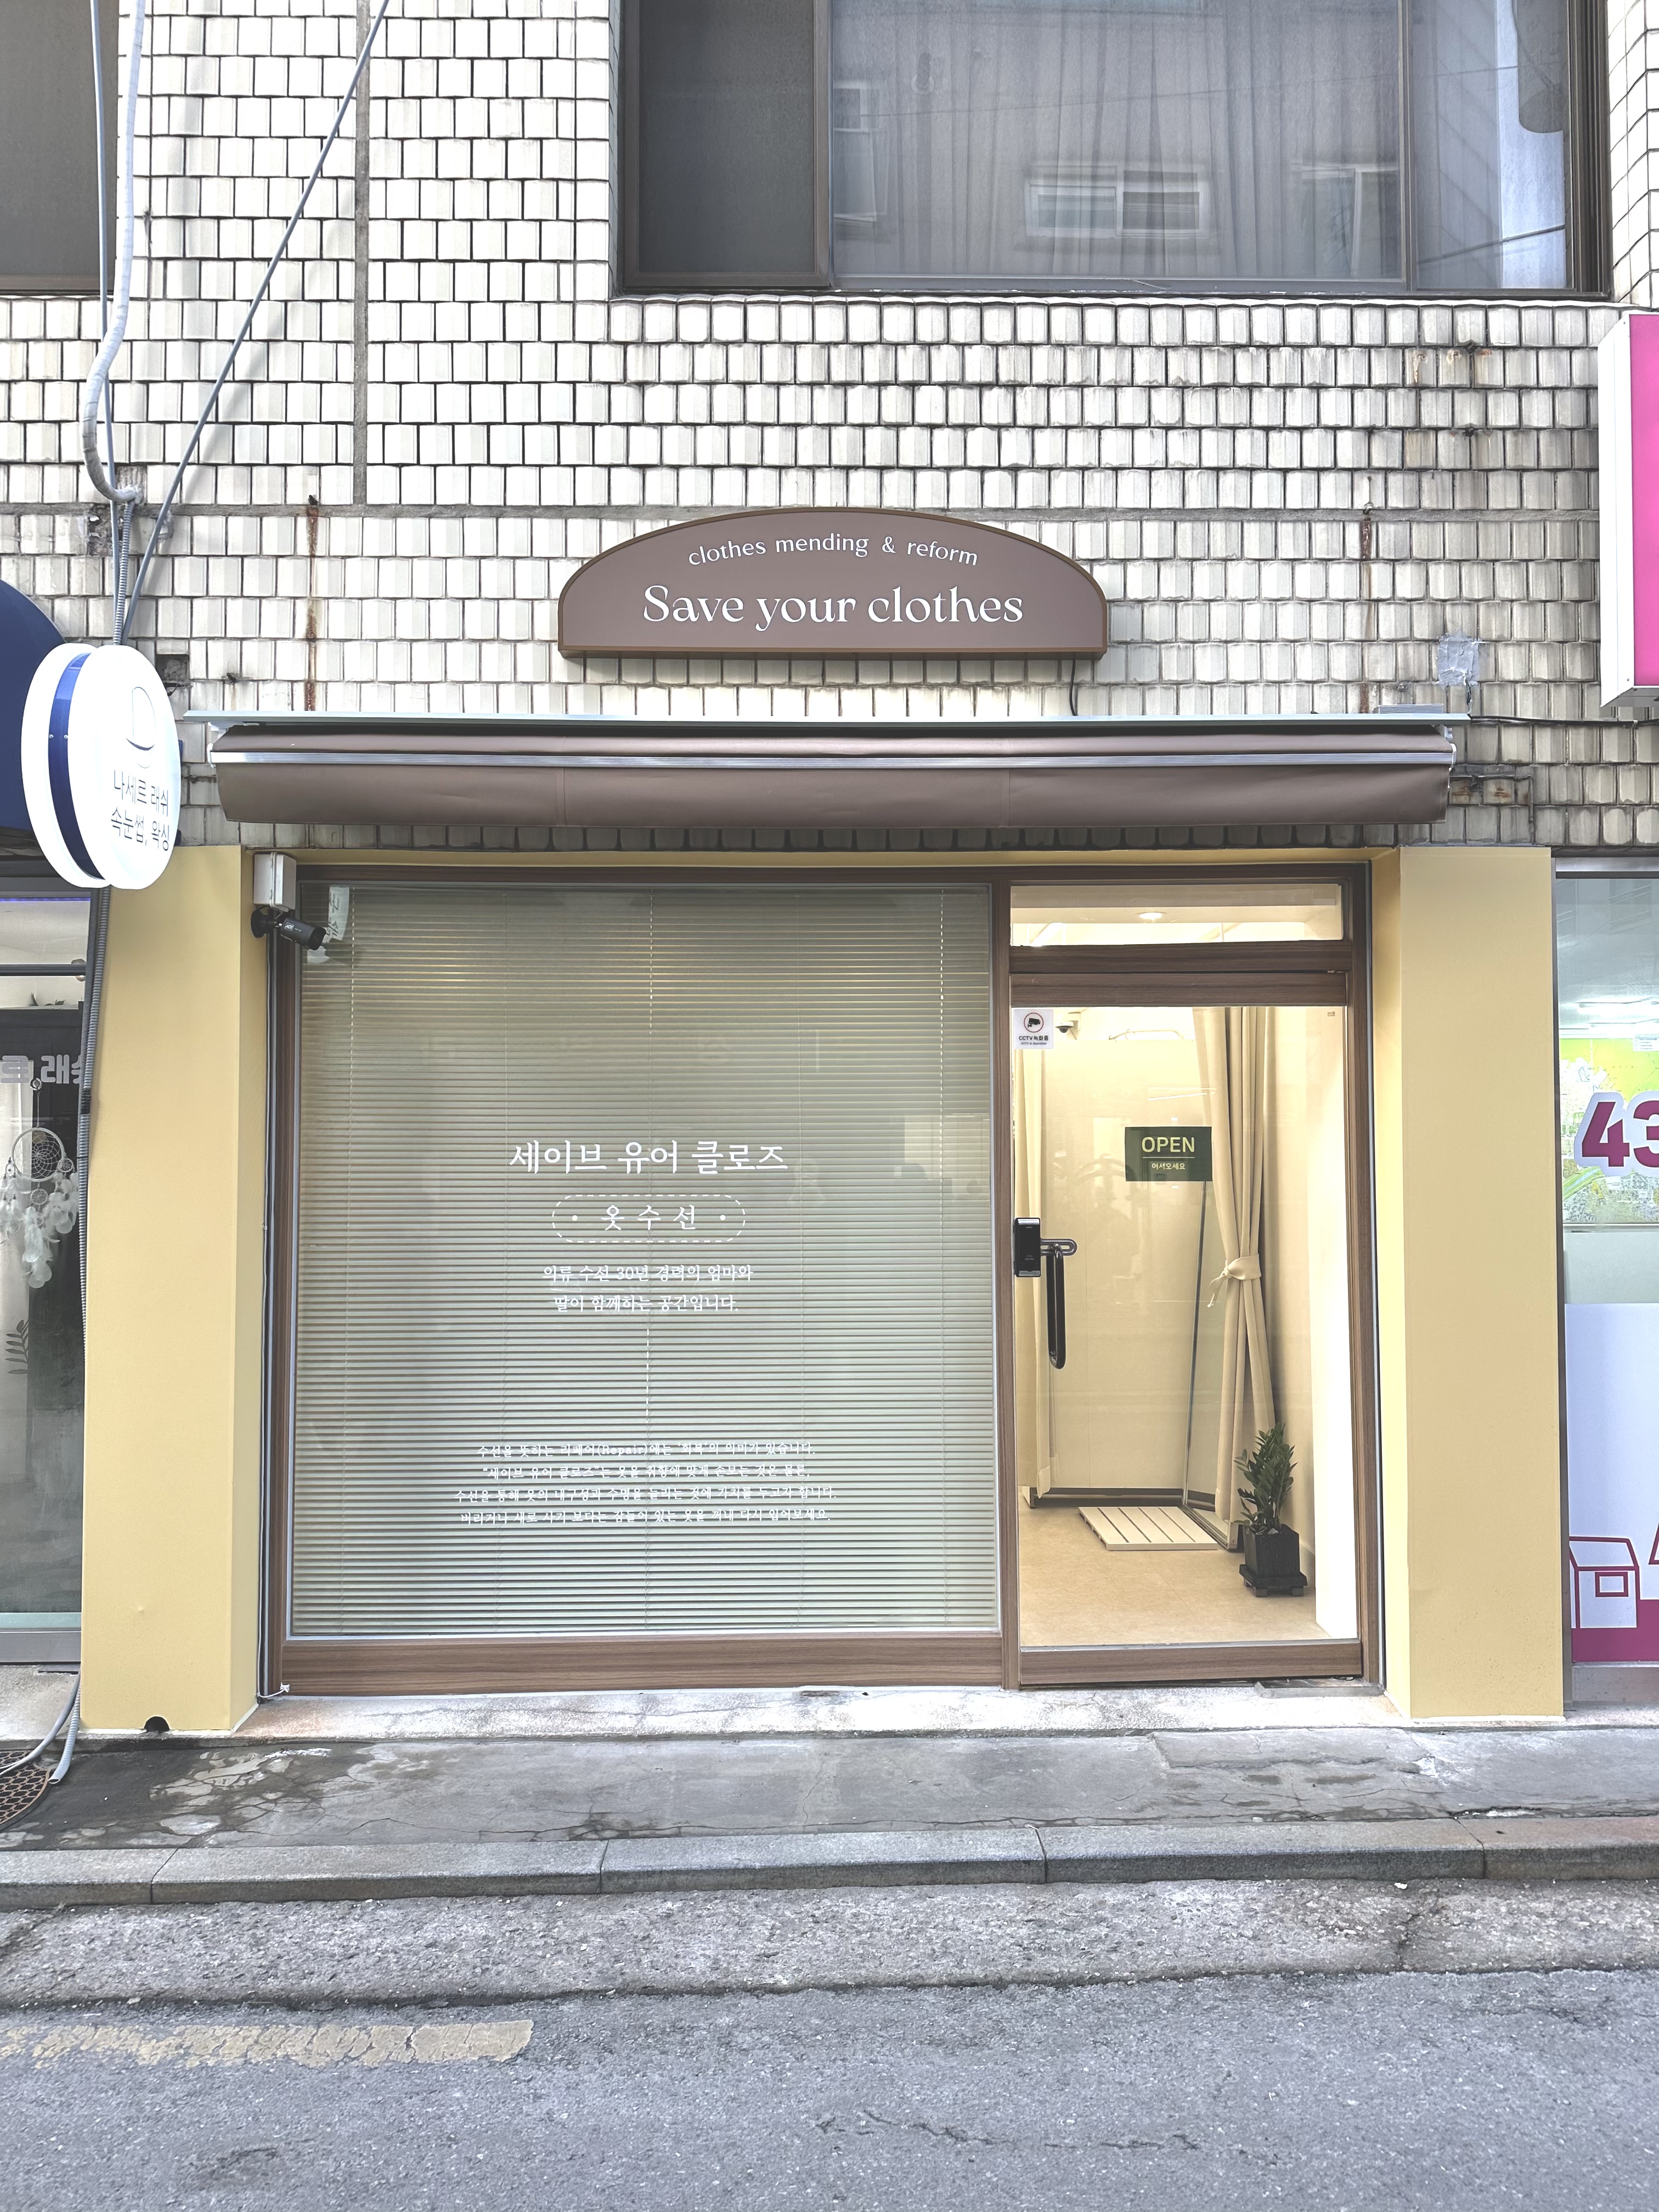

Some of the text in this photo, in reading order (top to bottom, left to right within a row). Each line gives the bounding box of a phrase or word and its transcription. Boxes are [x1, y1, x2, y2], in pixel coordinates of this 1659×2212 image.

[689, 533, 977, 566] clothes mending & reform
[644, 585, 1023, 631] Save your clothes
[114, 769, 168, 817] 나세르 래쉬
[111, 806, 169, 851] 속눈썹, 왁싱
[1142, 1136, 1195, 1153] OPEN
[509, 1140, 788, 1175] 세이브 유어 클로즈
[543, 1264, 754, 1283] 의류 수선 30년 경력의 엄마와
[554, 1294, 738, 1312] 딸이 함께하는 공간입니다.
[477, 1444, 514, 1458] 수선을
[518, 1443, 555, 1458] 뜻하는
[725, 1442, 761, 1455] 의미가
[765, 1441, 816, 1455] 있습니다.
[529, 1466, 552, 1480] 유어
[618, 1465, 641, 1478] 옷을
[645, 1464, 680, 1478] 취향에
[686, 1464, 709, 1477] 맞게
[714, 1464, 750, 1477] 손보는
[754, 1464, 779, 1477] 것은
[782, 1464, 810, 1477] 물론,
[454, 1485, 837, 1503] 수선을 통해 옷의 내구성과 수명을 늘리는 것에 가치를 두고자 합니다.
[460, 1508, 831, 1525] 버리거나 새로 사기 보다는 잠들어 있는 옷을 꺼내 다시 입어보세요.
